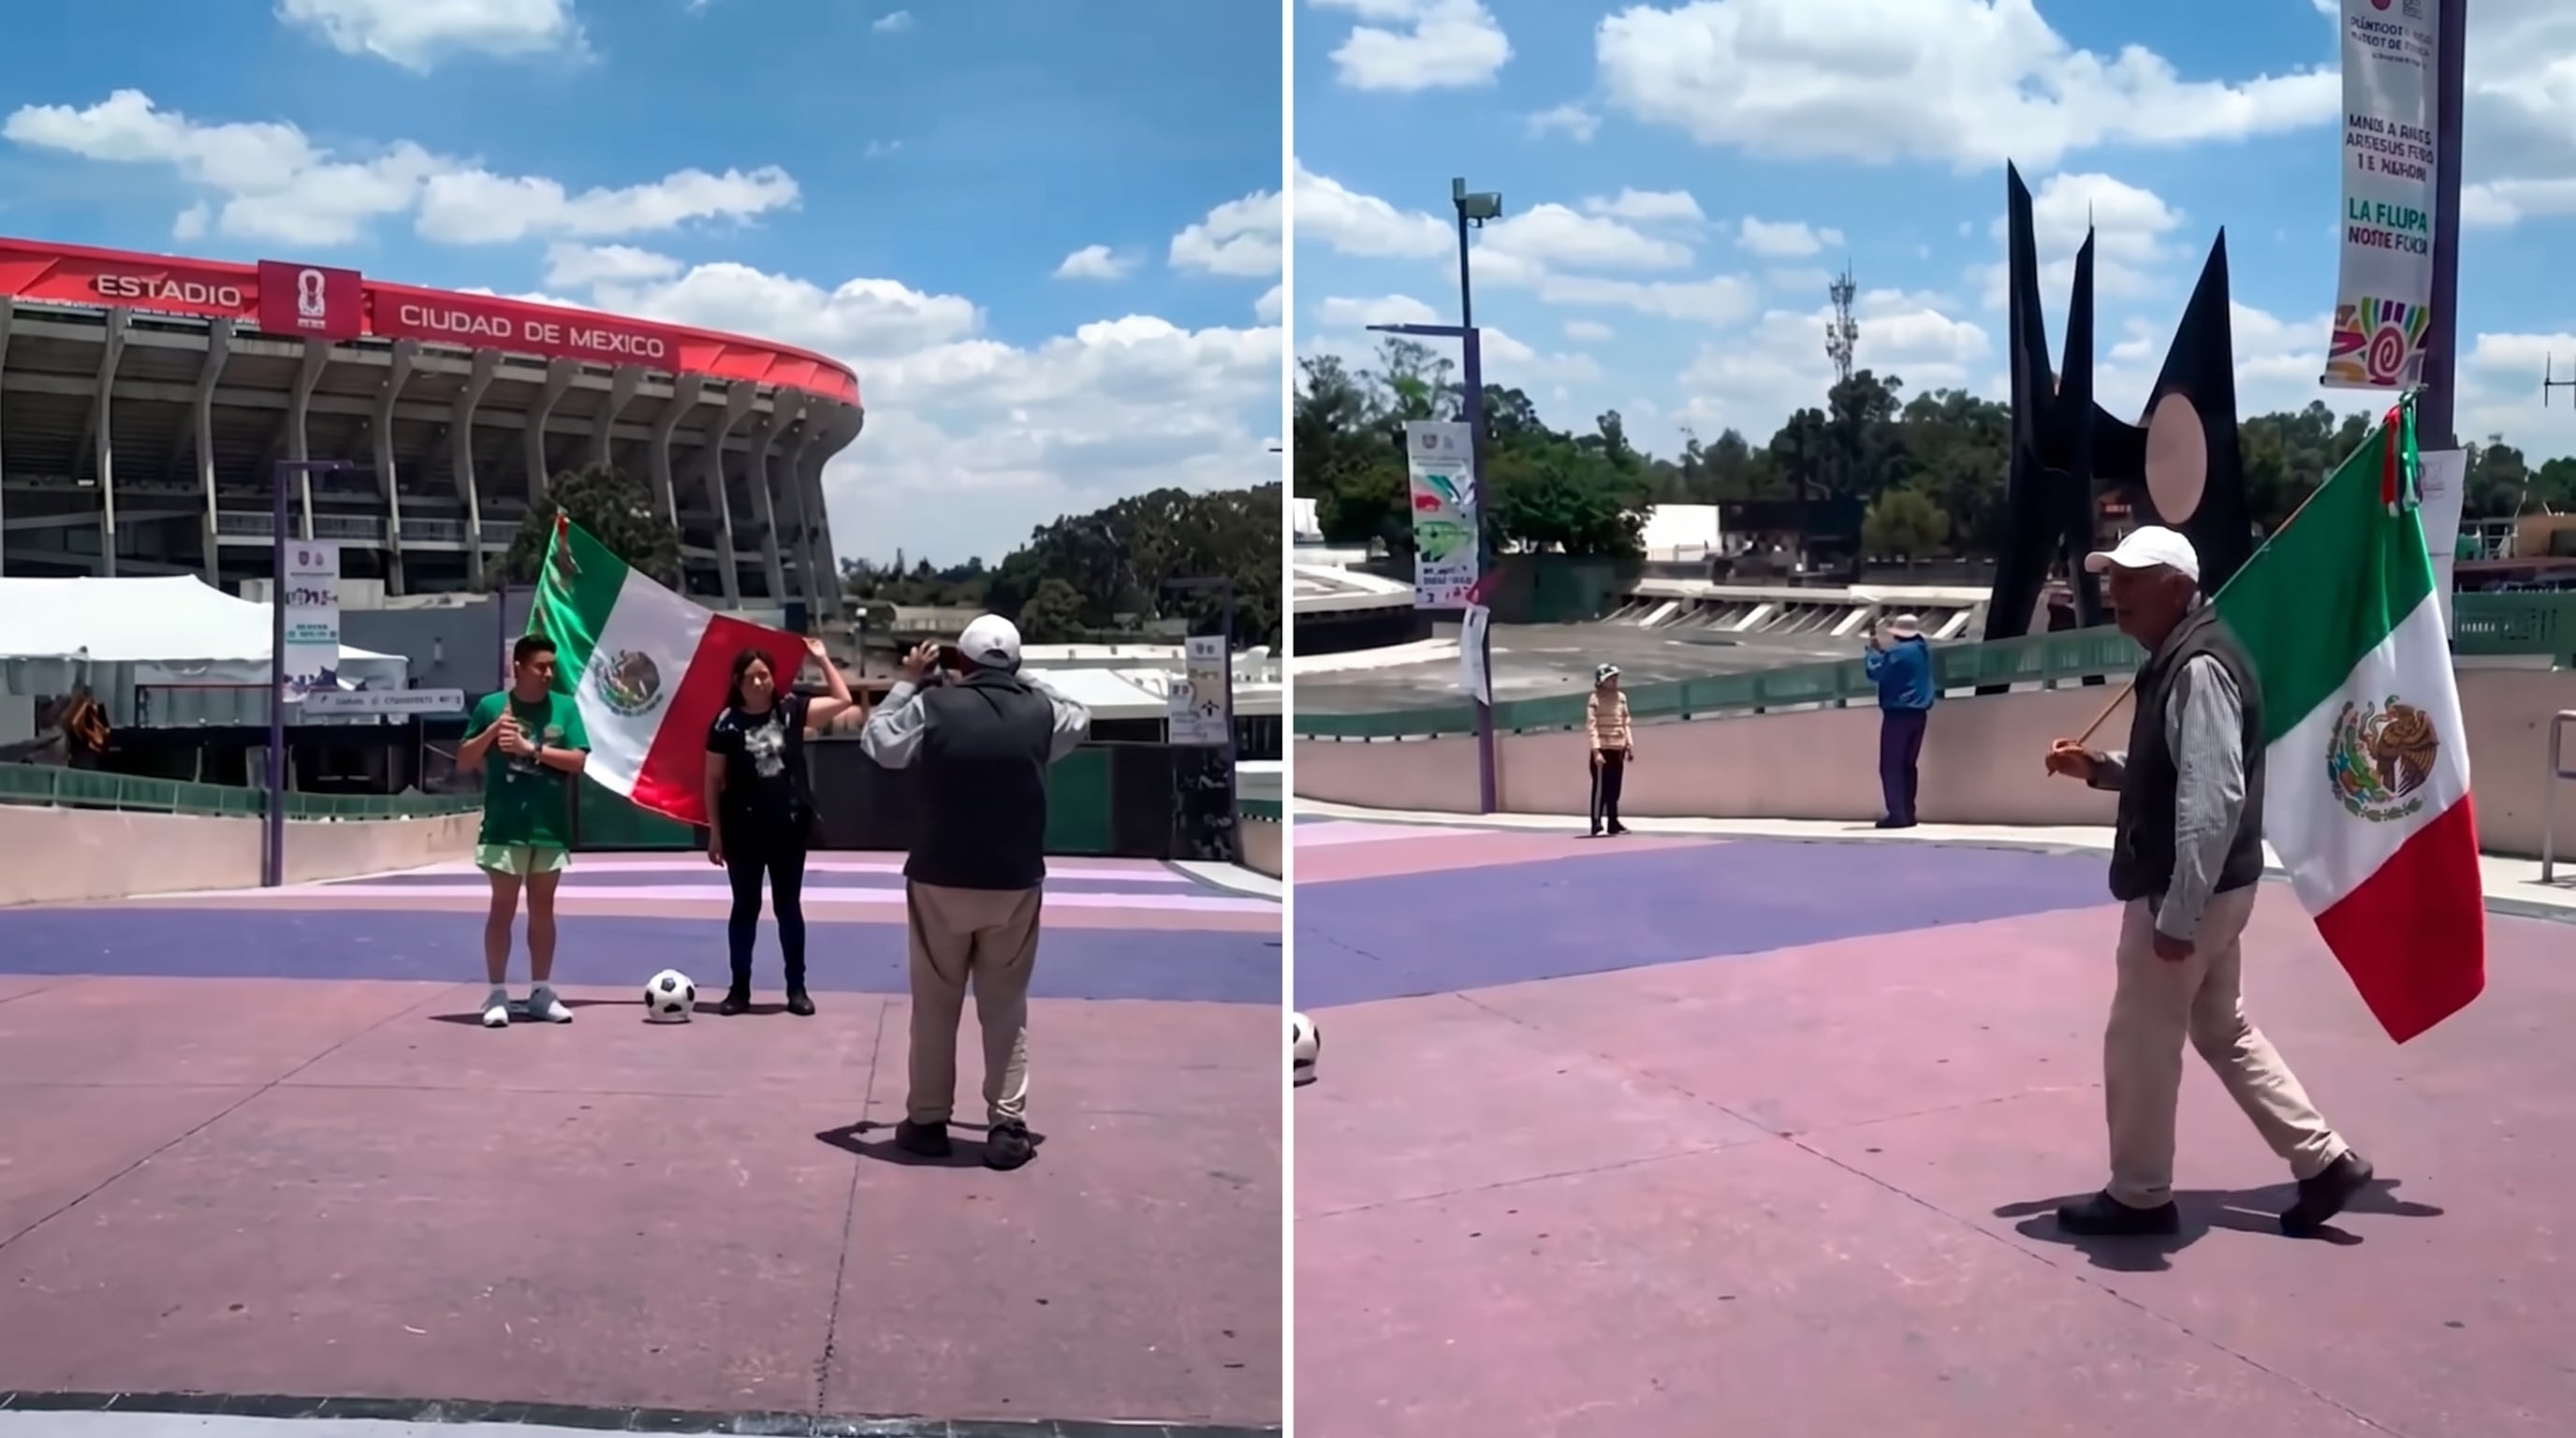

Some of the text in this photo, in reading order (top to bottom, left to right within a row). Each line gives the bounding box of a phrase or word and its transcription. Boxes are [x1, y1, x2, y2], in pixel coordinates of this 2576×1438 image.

[2349, 197, 2427, 233] LA FLUPA
[97, 274, 241, 307] ESTADIO
[400, 304, 665, 359] CIUDAD DE MEXICO
